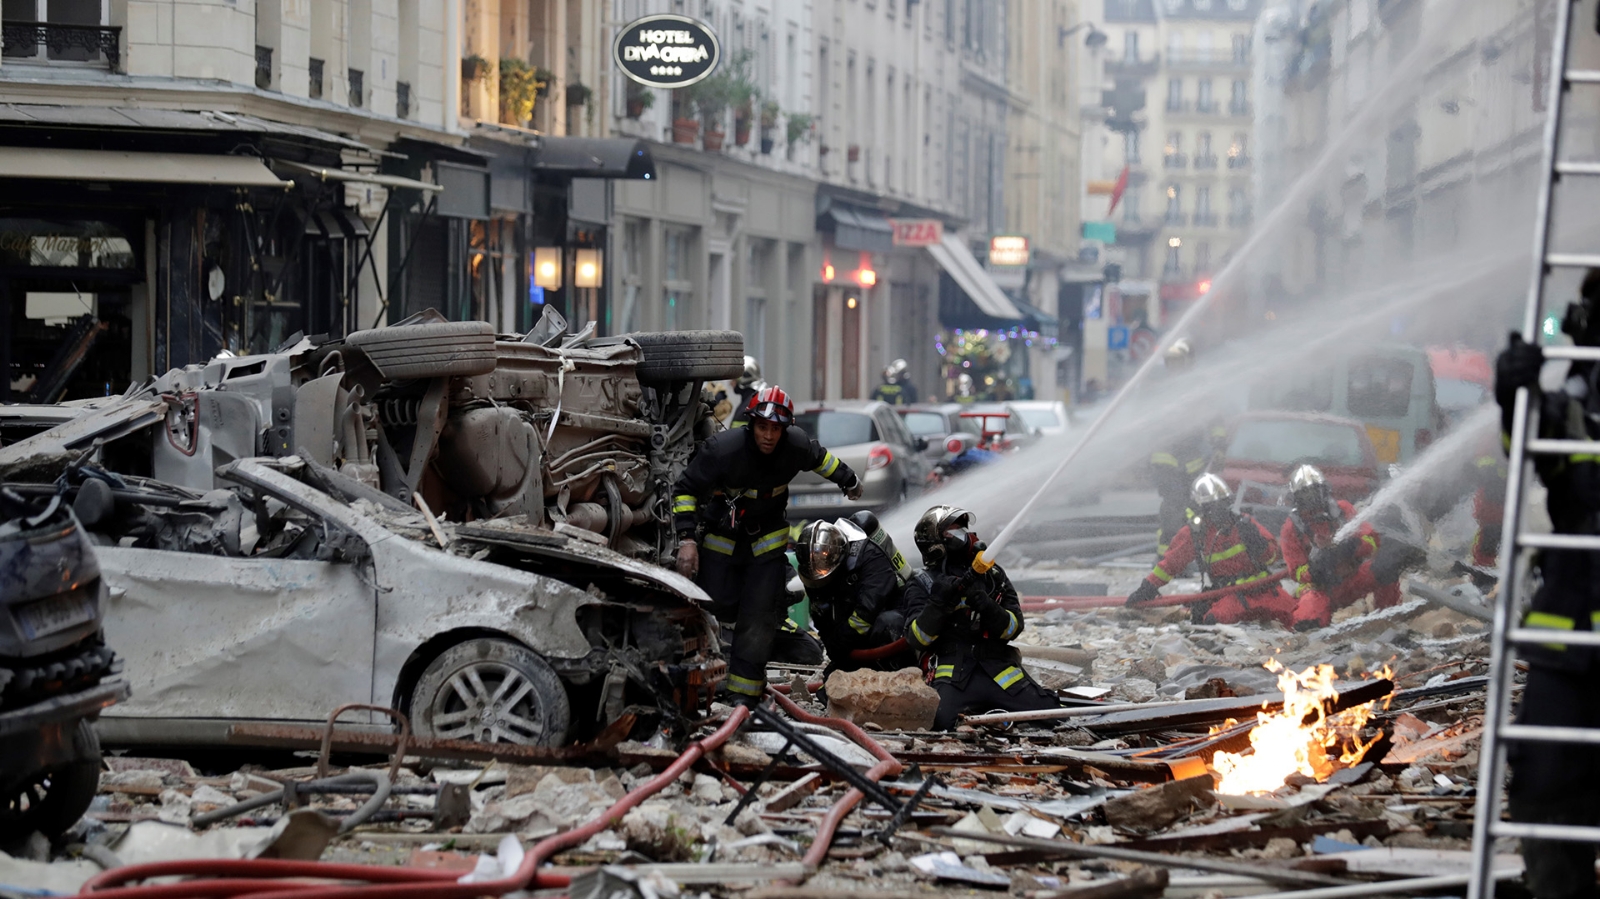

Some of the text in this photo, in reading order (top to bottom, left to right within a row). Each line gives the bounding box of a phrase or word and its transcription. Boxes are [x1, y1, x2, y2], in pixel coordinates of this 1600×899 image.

[639, 29, 694, 44] HOTEL
[623, 43, 709, 63] DIVA OPERA
